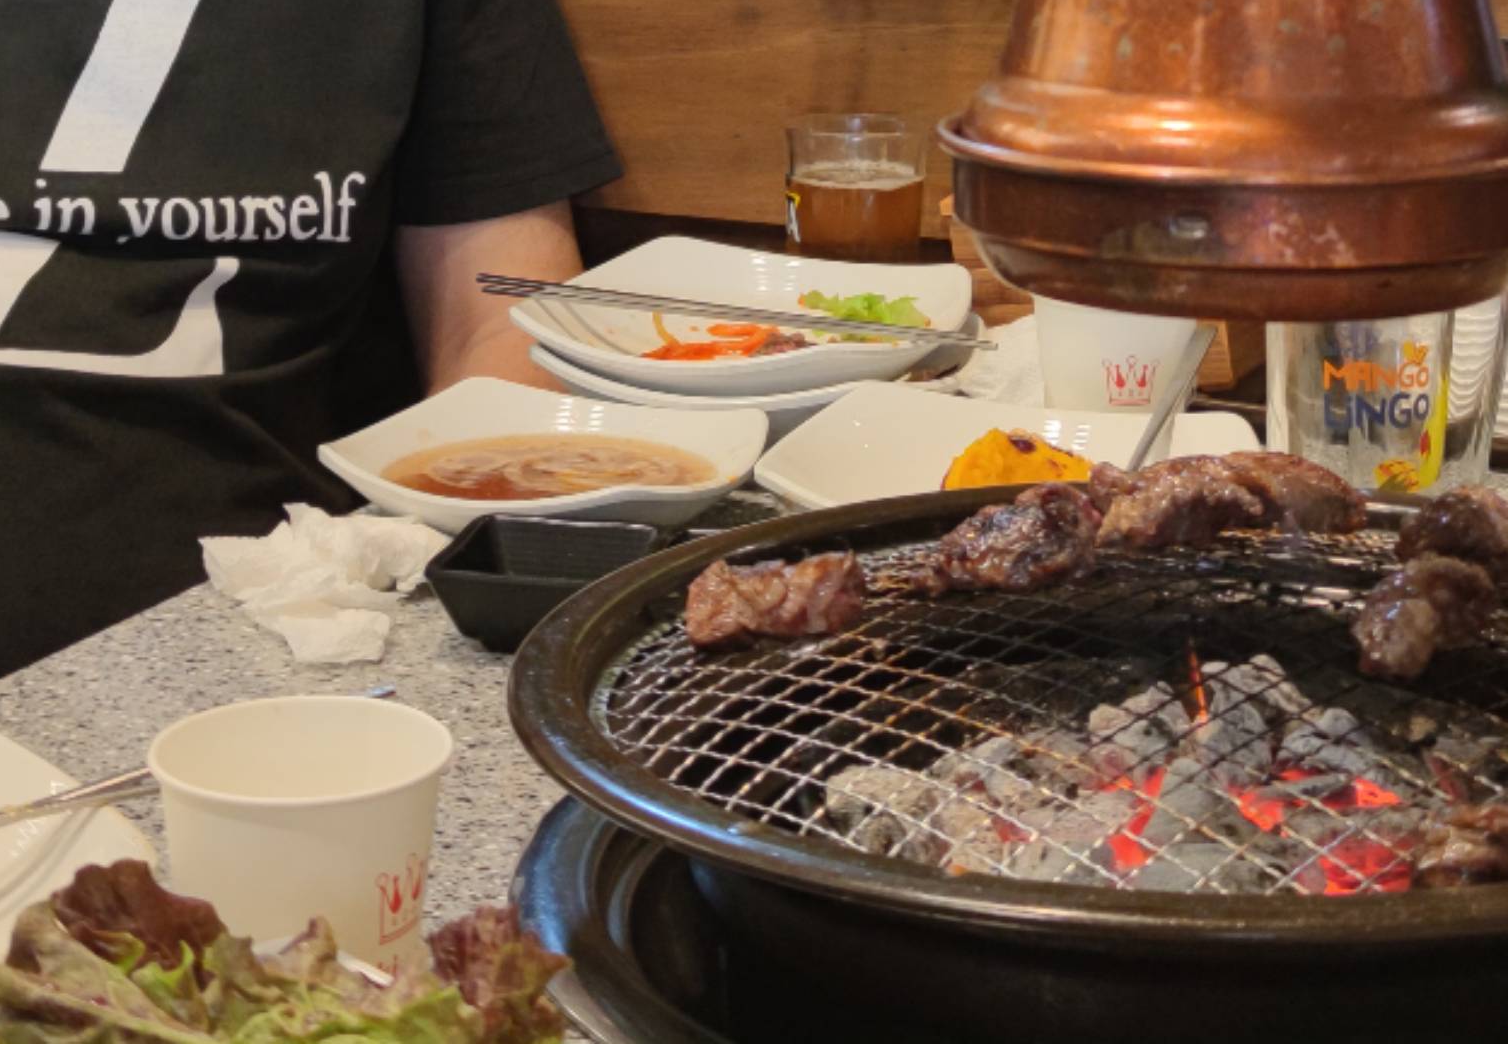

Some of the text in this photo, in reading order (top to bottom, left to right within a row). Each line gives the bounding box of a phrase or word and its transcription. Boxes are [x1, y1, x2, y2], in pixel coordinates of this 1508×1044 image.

[33, 178, 97, 236] in
[117, 172, 366, 245] yourself
[1323, 357, 1430, 392] MANGO
